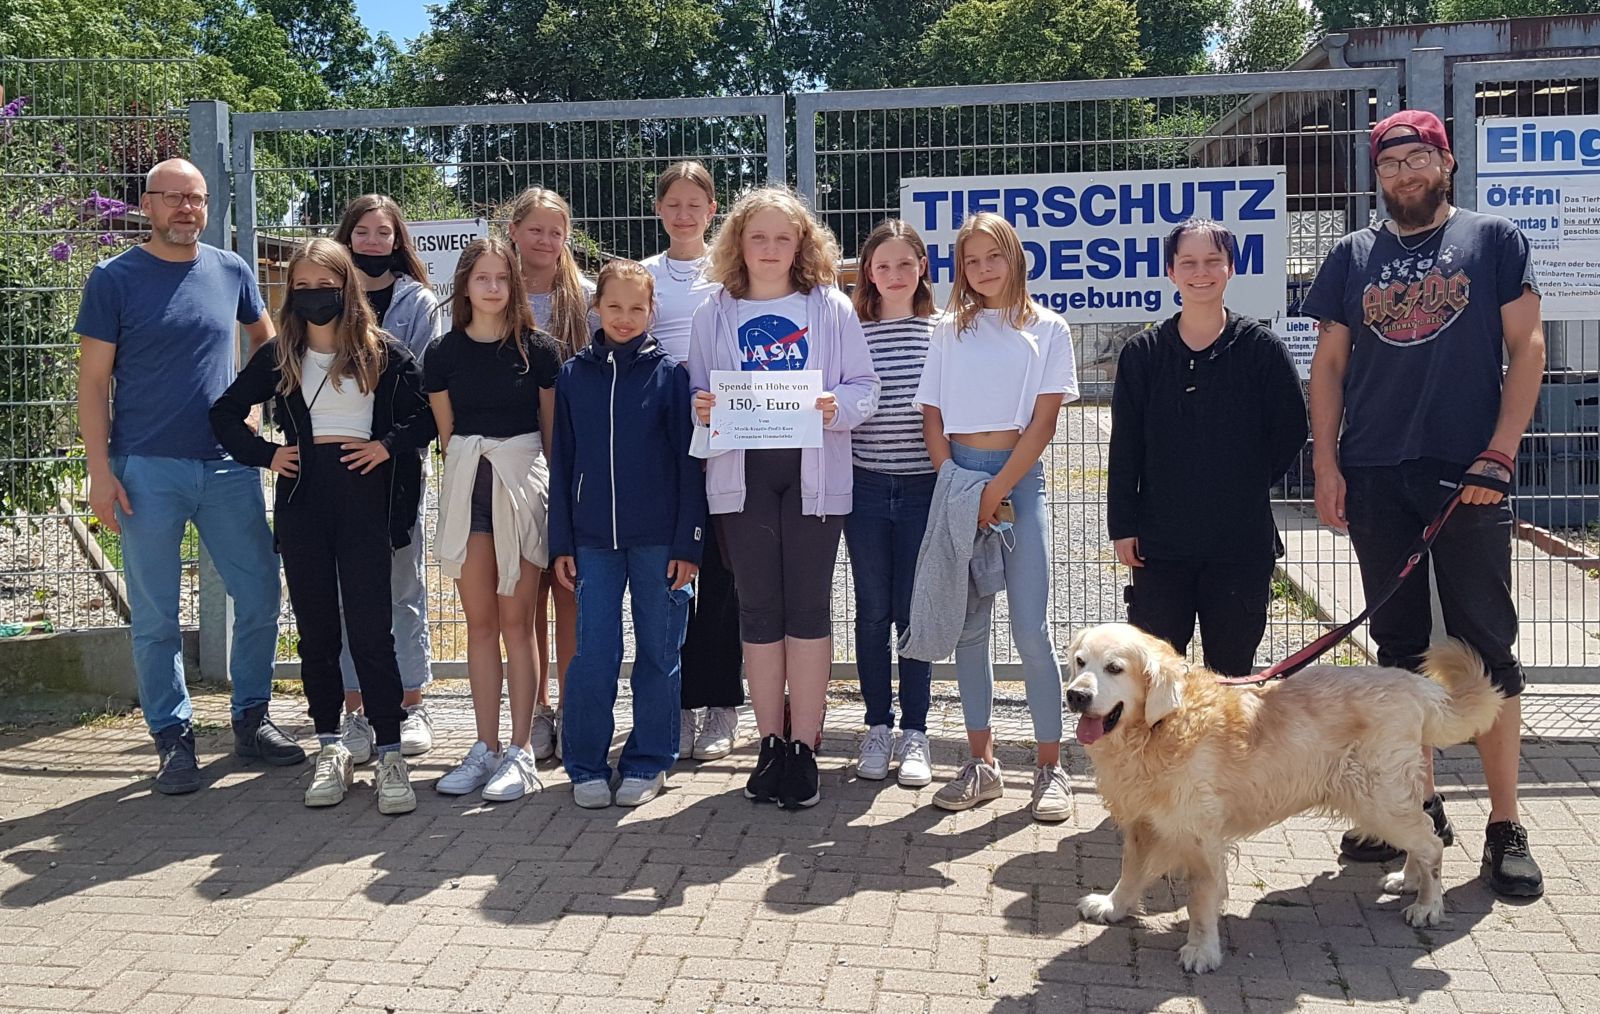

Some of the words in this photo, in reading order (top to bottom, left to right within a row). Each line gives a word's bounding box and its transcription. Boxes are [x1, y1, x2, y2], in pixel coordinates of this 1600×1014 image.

[1487, 184, 1560, 207] Öffn
[913, 179, 1276, 231] TIERSCHUTZ
[1577, 217, 1590, 225] auf
[1564, 228, 1600, 236] geschlos
[1542, 260, 1566, 268] Fragen
[1286, 322, 1310, 332] Liebe
[718, 382, 752, 392] Spende
[754, 382, 763, 391] in
[766, 382, 790, 391] Höhe
[728, 398, 762, 412] 150,-
[766, 398, 800, 411] Euro
